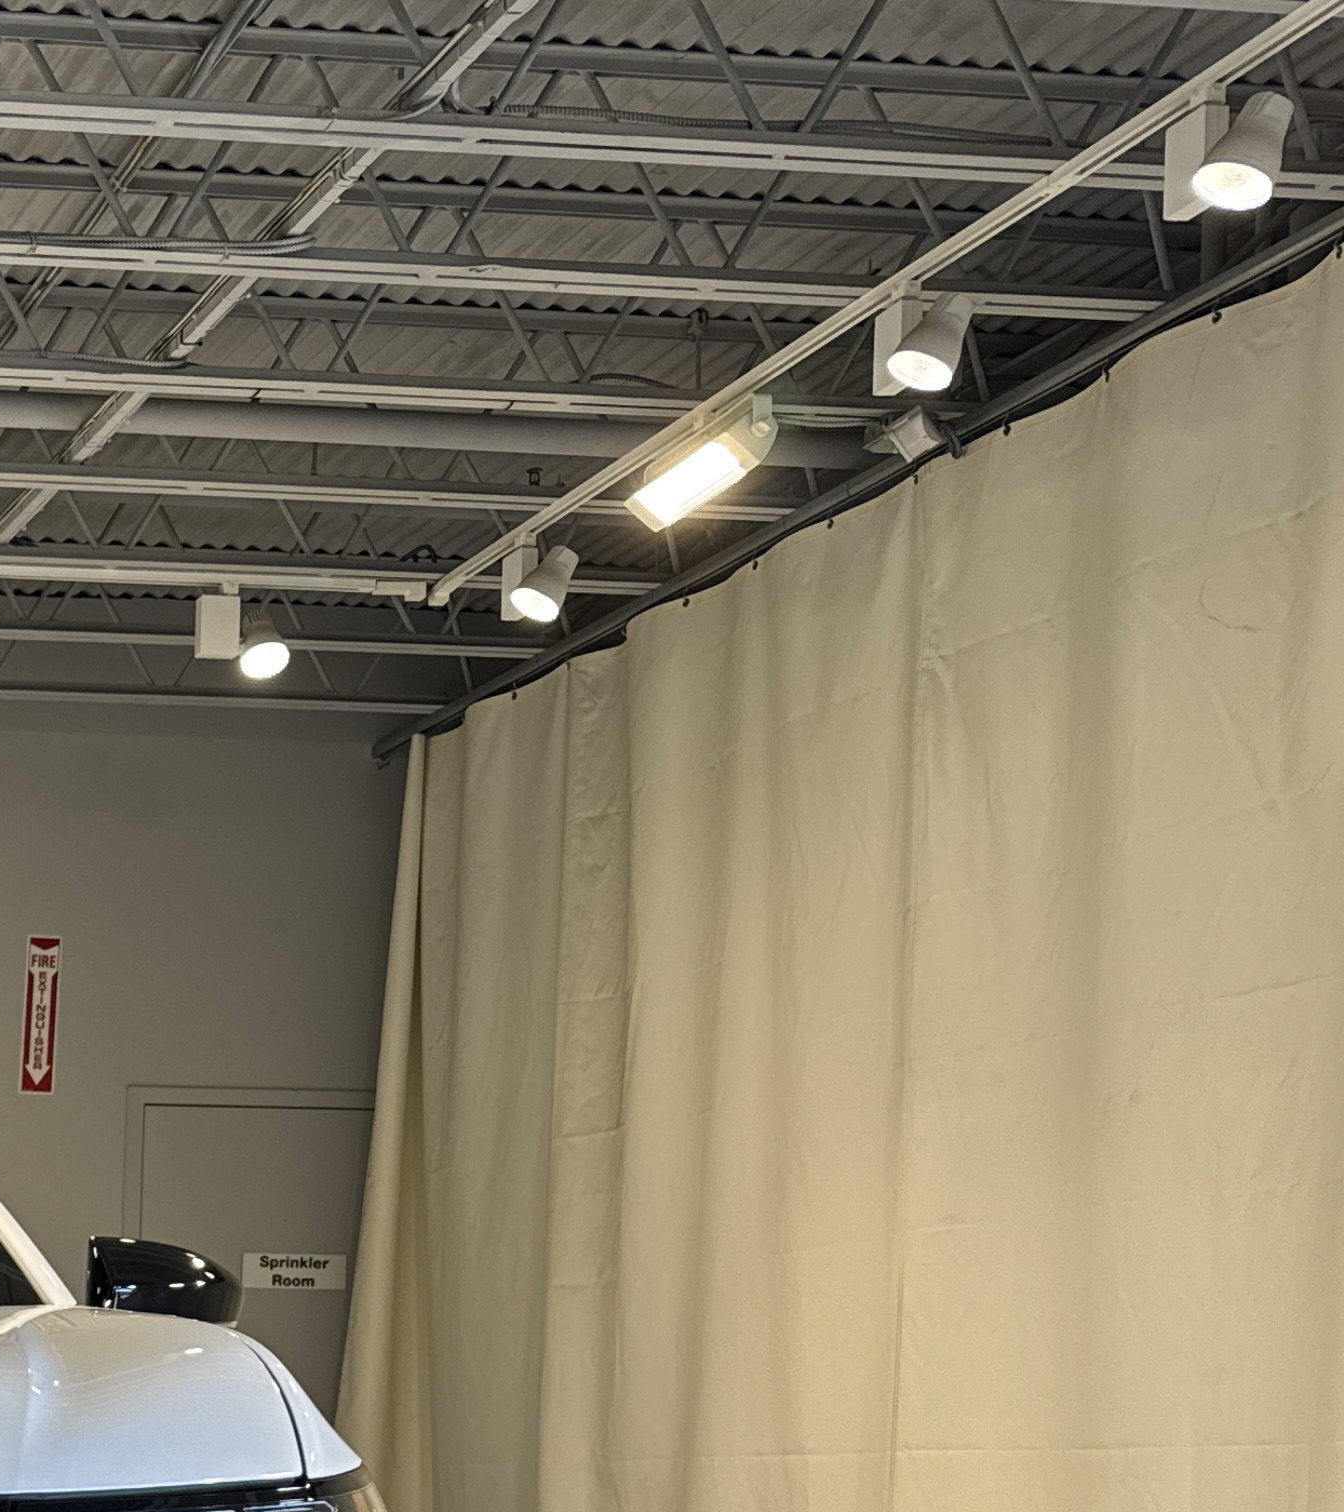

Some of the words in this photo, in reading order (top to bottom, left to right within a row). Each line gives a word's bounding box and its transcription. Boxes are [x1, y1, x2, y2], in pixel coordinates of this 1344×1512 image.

[31, 954, 56, 969] FIRE
[33, 971, 47, 1070] EXTINGUISHER
[259, 1255, 330, 1270] Sprinkler
[272, 1274, 315, 1287] Room
